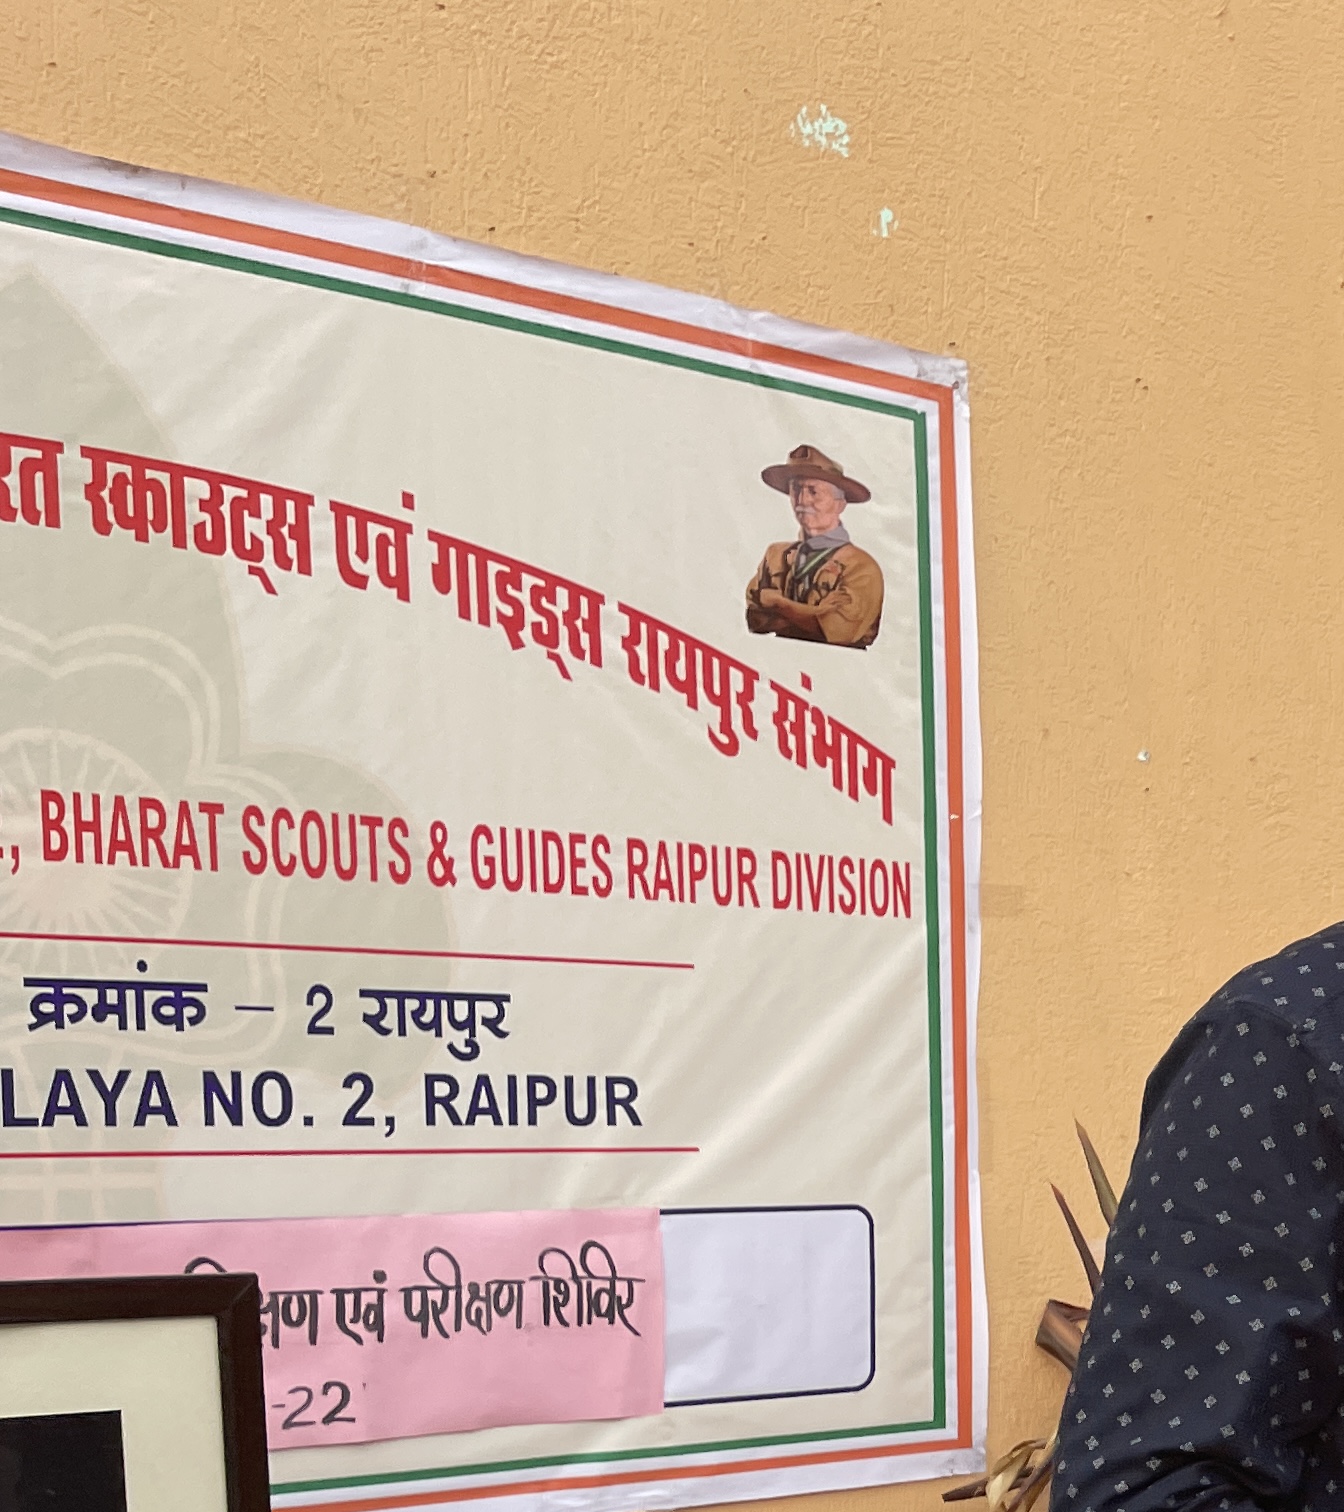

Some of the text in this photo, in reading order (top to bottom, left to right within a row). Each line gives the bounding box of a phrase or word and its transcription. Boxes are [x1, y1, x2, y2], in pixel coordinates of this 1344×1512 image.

[80, 445, 315, 596] स्काउट्स
[329, 490, 415, 604] एवं
[428, 528, 605, 682] गाइड्स
[617, 601, 759, 758] रायपुर
[770, 670, 896, 826] संभाग
[41, 788, 225, 872] BHARAT
[241, 804, 411, 884] SCOUTS
[427, 820, 457, 887] &
[470, 824, 613, 899] GUIDES
[627, 837, 760, 908] RAIPUR
[771, 850, 911, 919] DIVISION
[23, 959, 208, 1032] क्रमांक
[305, 984, 336, 1037] 2
[359, 988, 511, 1062] रायपुर
[0, 1068, 644, 1139] LAYA NO. 2, RAIPUR
[331, 1270, 388, 1346] एवं
[399, 1246, 526, 1341] परीक्षण
[530, 1240, 646, 1338] शिविर
